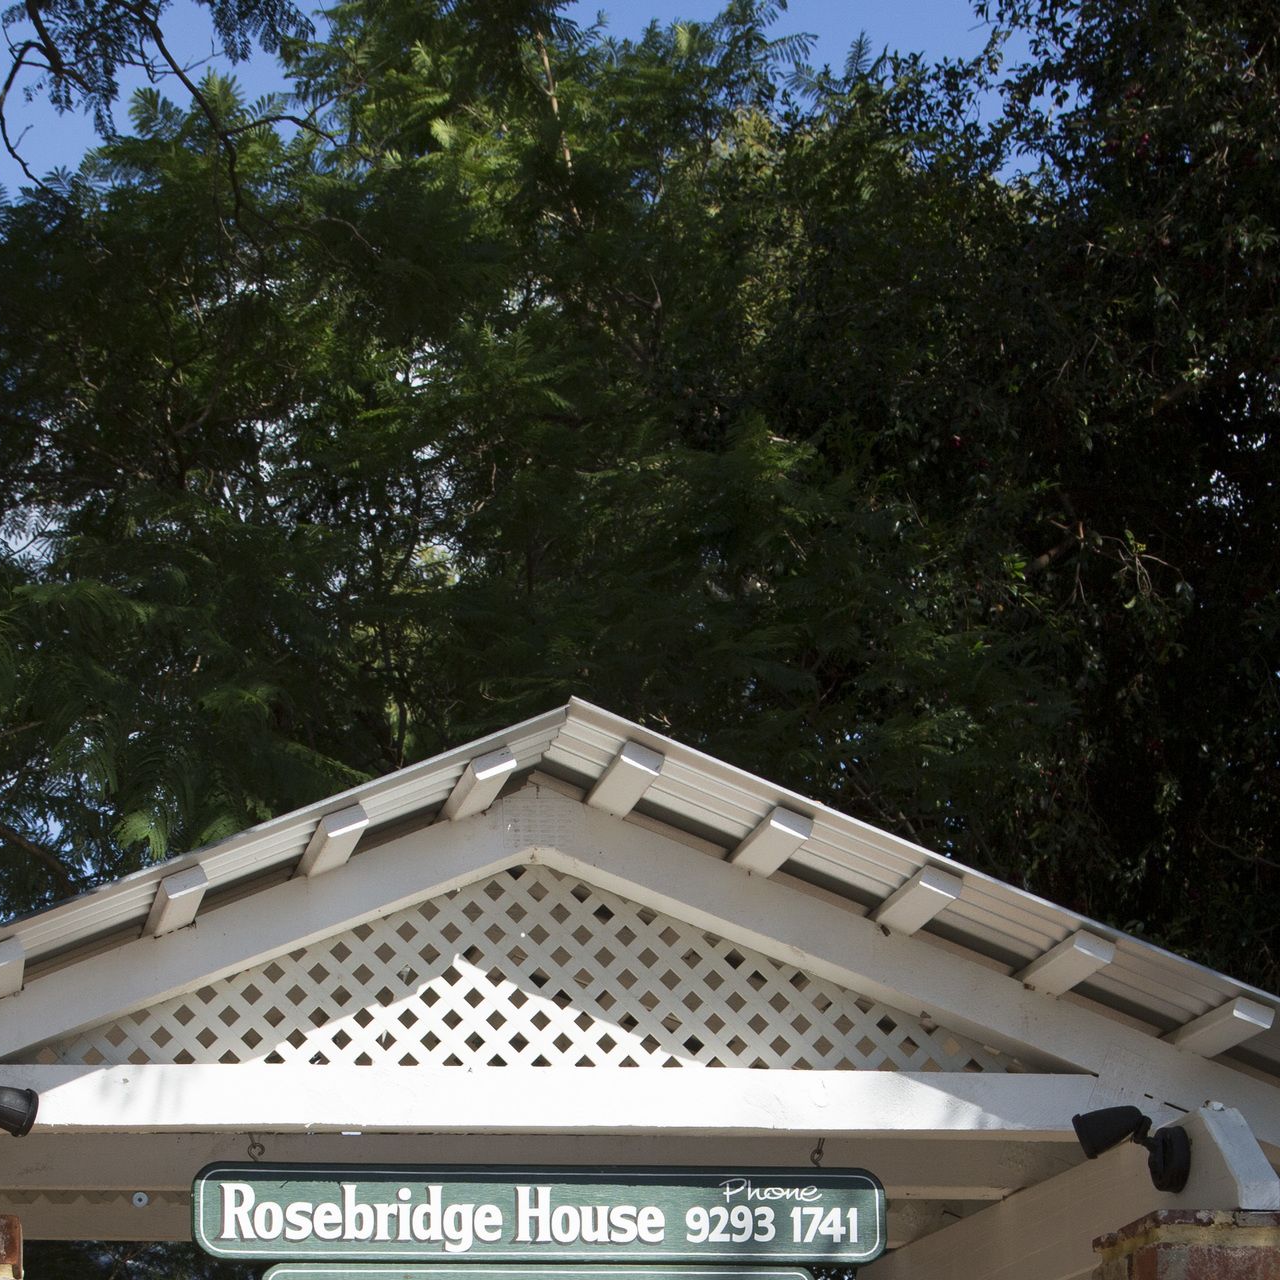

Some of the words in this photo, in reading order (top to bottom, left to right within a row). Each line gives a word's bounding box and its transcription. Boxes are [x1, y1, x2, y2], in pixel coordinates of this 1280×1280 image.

[719, 1178, 822, 1203] Phone
[219, 1183, 502, 1252] Rosebridge
[516, 1186, 665, 1243] House
[685, 1205, 776, 1244] 9293
[789, 1207, 858, 1243] 1741
